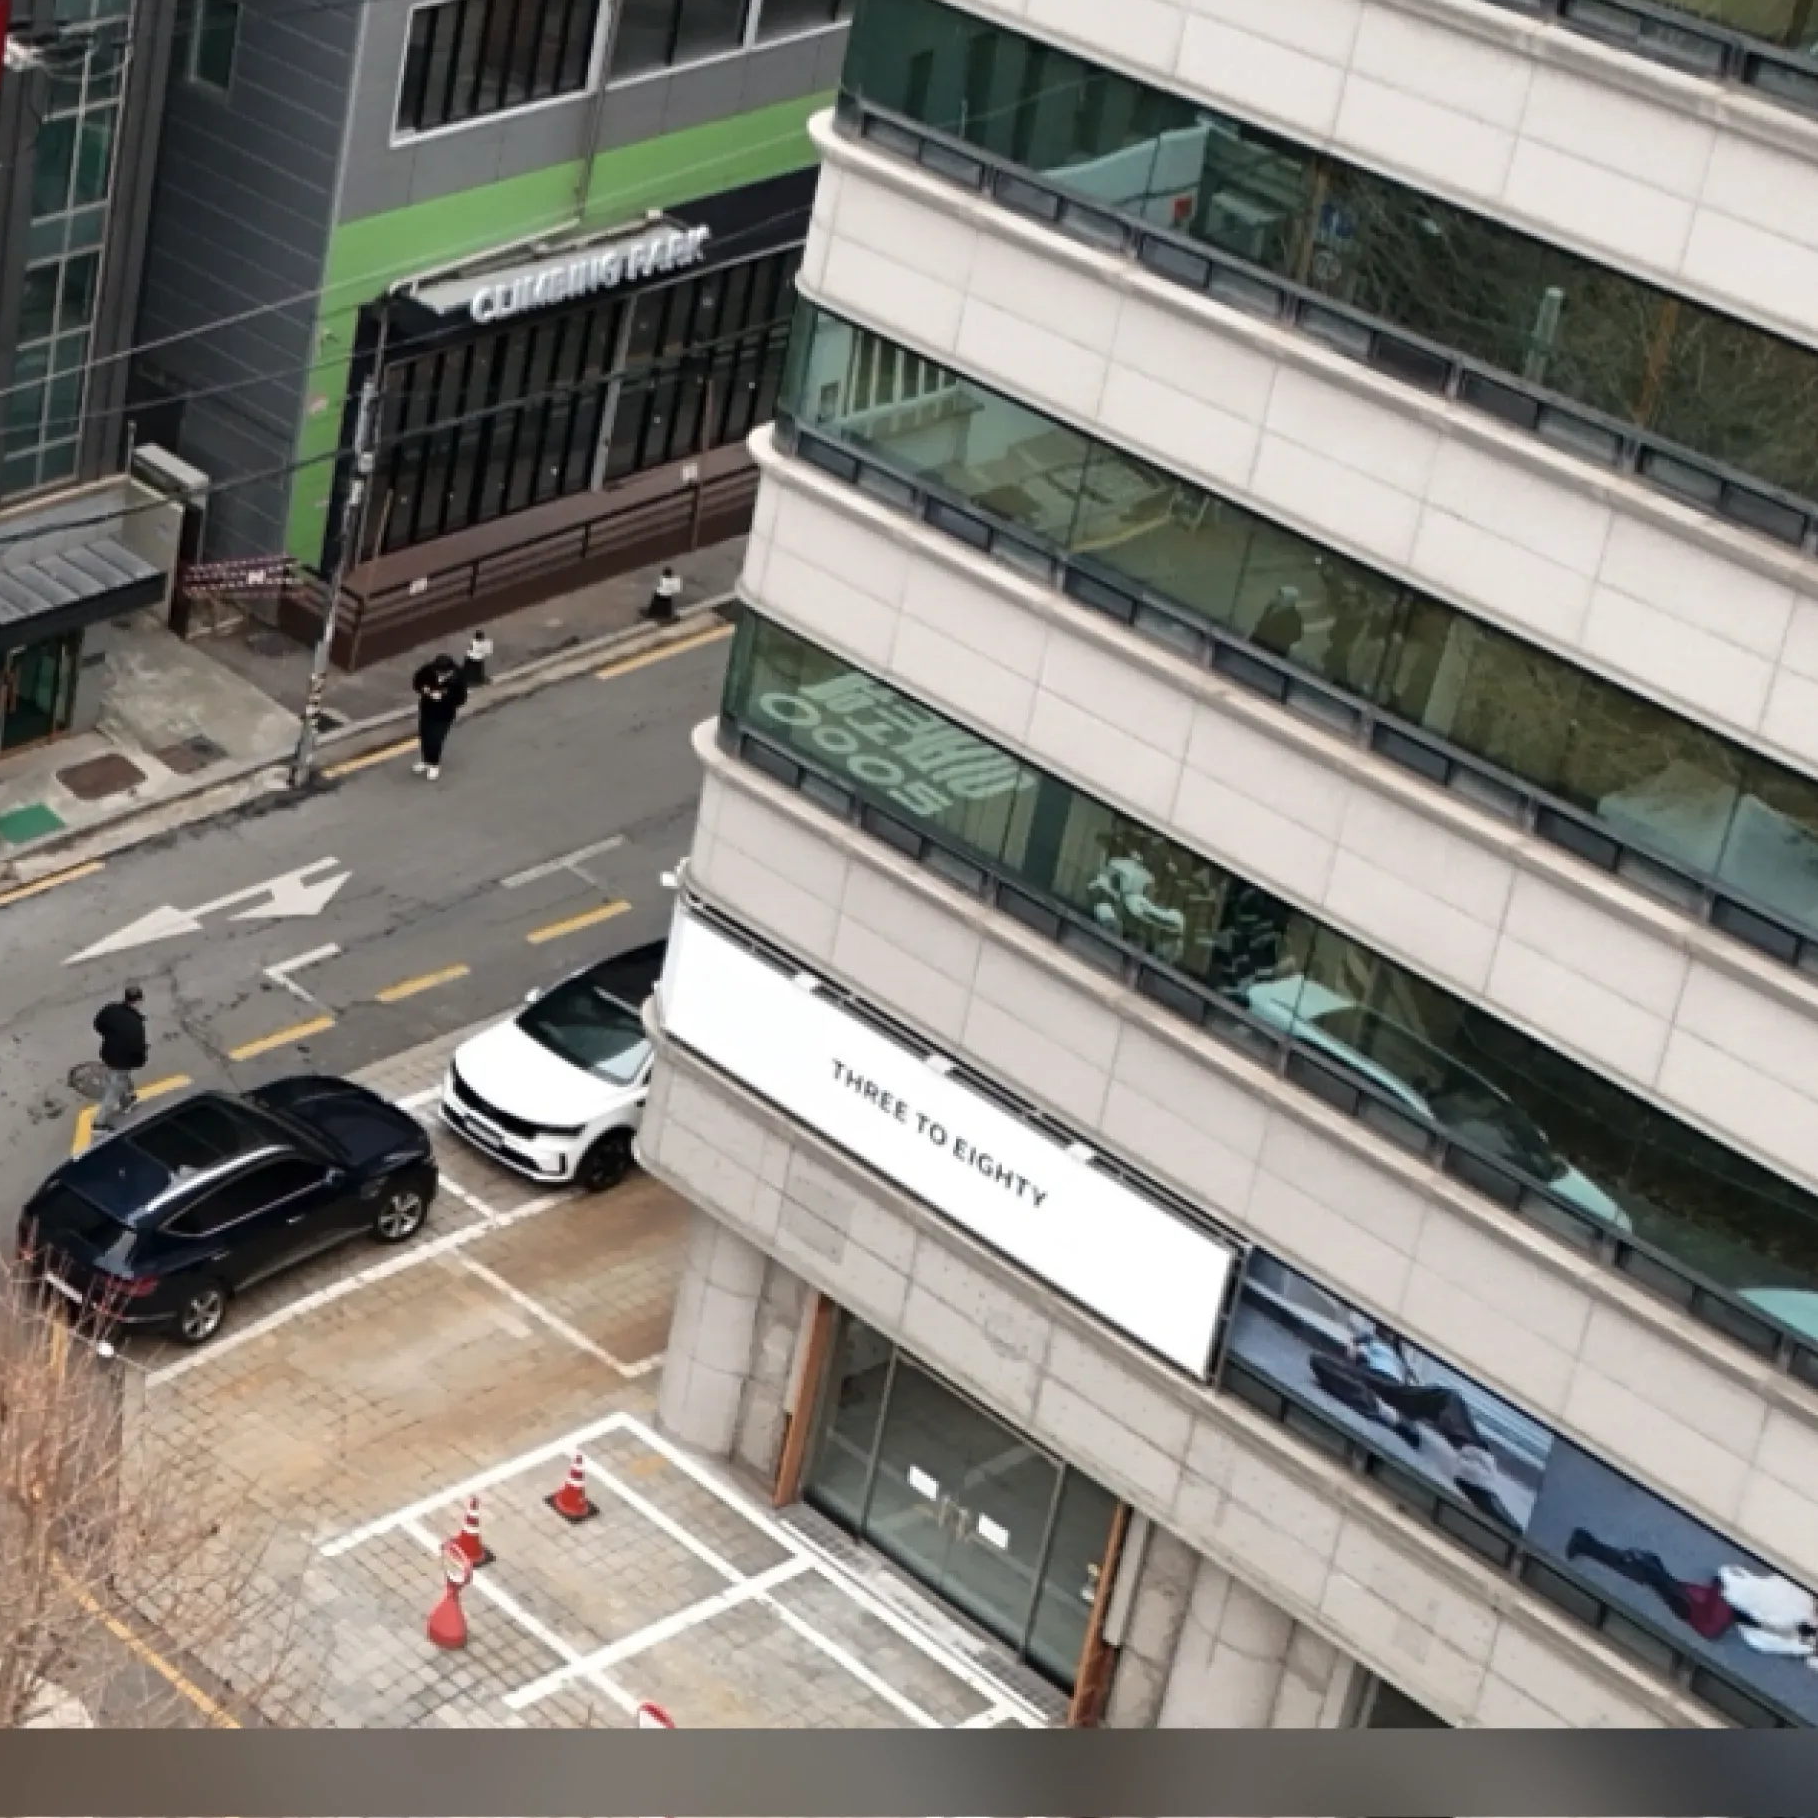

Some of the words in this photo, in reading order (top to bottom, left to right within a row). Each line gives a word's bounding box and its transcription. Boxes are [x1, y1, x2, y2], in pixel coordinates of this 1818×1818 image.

[831, 1058, 909, 1123] THREE
[916, 1112, 948, 1147] TO
[952, 1136, 1049, 1209] EIGHTY
